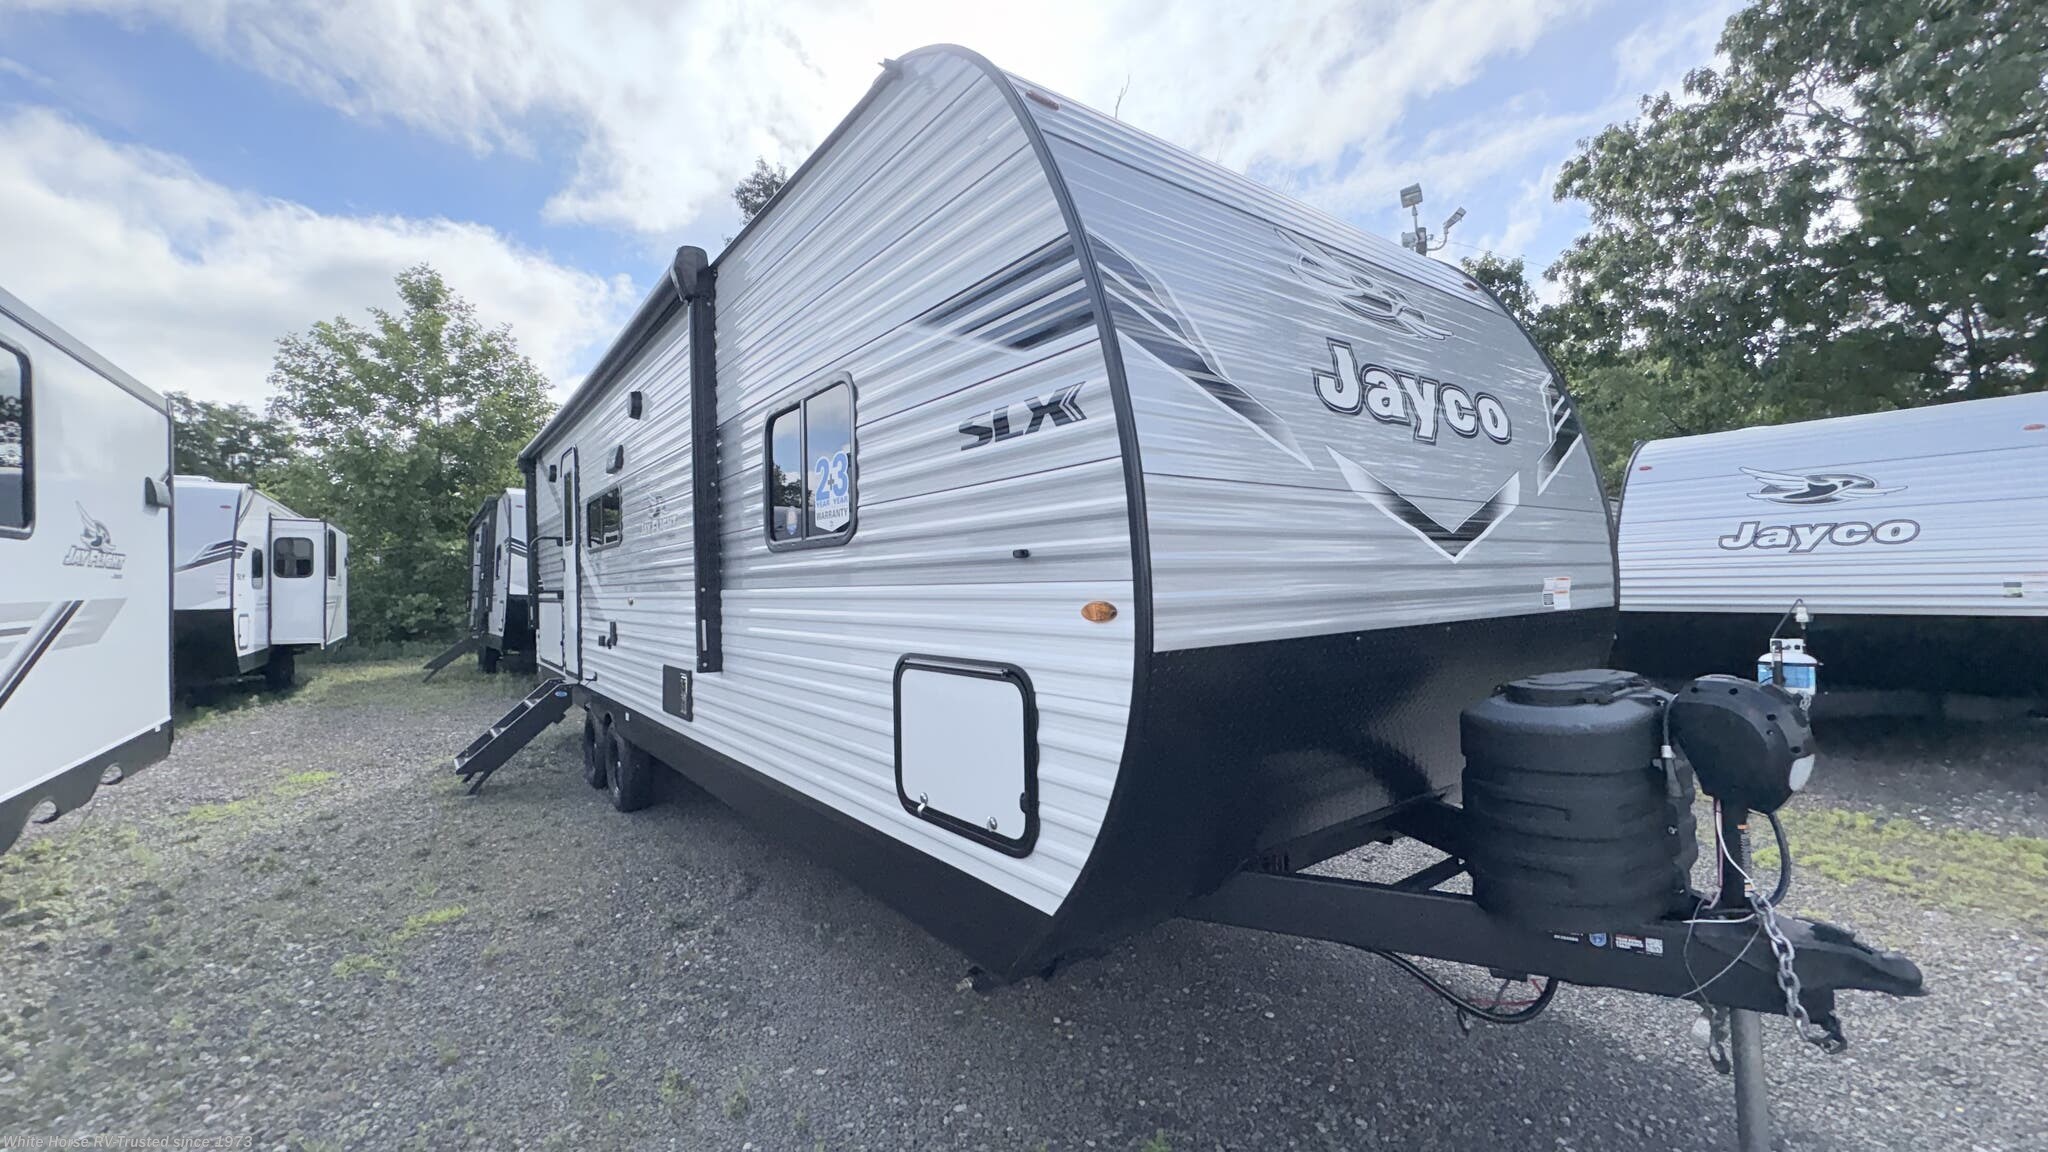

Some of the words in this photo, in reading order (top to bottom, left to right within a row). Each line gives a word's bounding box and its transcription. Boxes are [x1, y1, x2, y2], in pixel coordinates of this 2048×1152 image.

[958, 381, 1087, 451] SLX
[1311, 337, 1512, 445] Jayco
[816, 508, 848, 520] WARRANTY
[1718, 519, 1920, 553] Jayco
